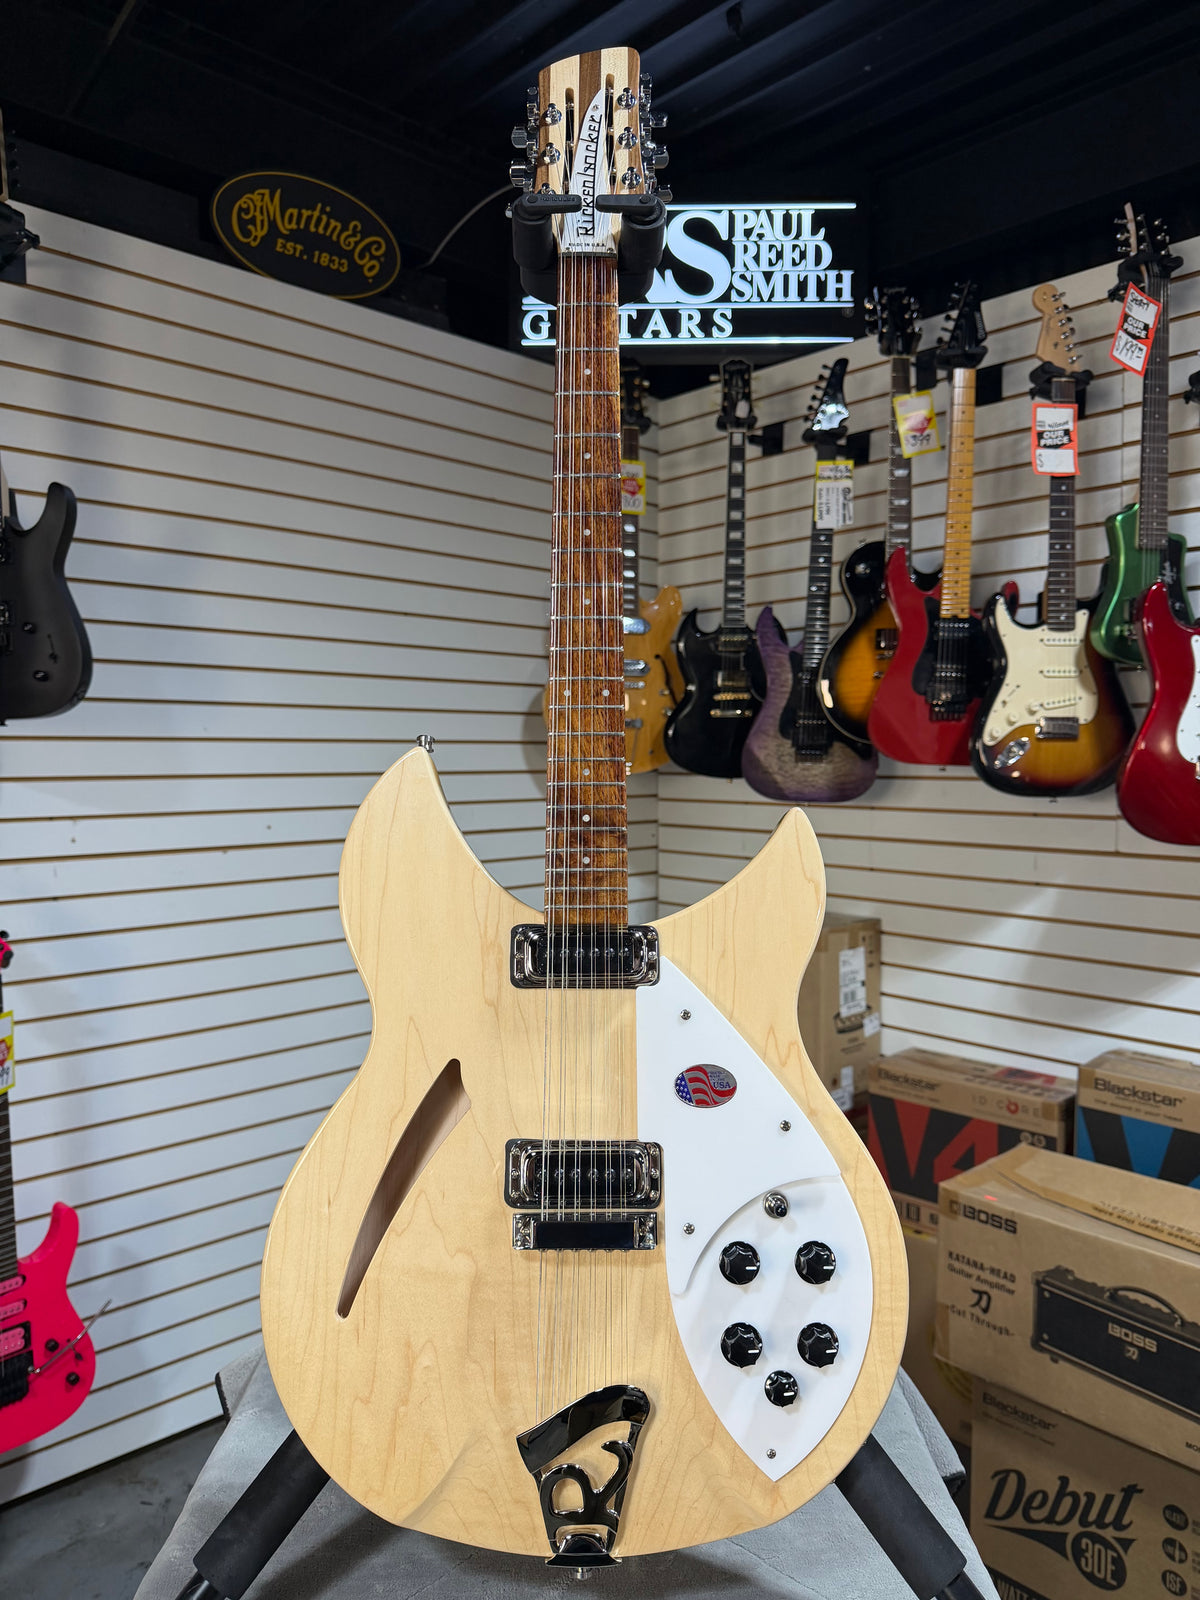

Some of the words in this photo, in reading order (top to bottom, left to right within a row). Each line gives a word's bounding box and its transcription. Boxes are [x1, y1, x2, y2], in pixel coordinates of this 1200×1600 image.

[731, 209, 826, 241] PAUL
[275, 238, 308, 260] EST.
[312, 252, 349, 273] 1833
[731, 240, 833, 272] REED
[730, 269, 855, 303] SMITH
[522, 308, 733, 340] GTARS
[1122, 322, 1148, 339] PRICE
[1127, 316, 1145, 330] OUR
[1039, 435, 1070, 447] PRICE
[1042, 430, 1065, 440] OUR
[713, 1081, 731, 1089] USA
[1094, 1077, 1184, 1108] Blackstar
[962, 1203, 1018, 1235] BOSS
[1108, 1322, 1158, 1353] BOSS
[984, 1468, 1144, 1532] Debut
[1079, 1537, 1119, 1588] 30E
